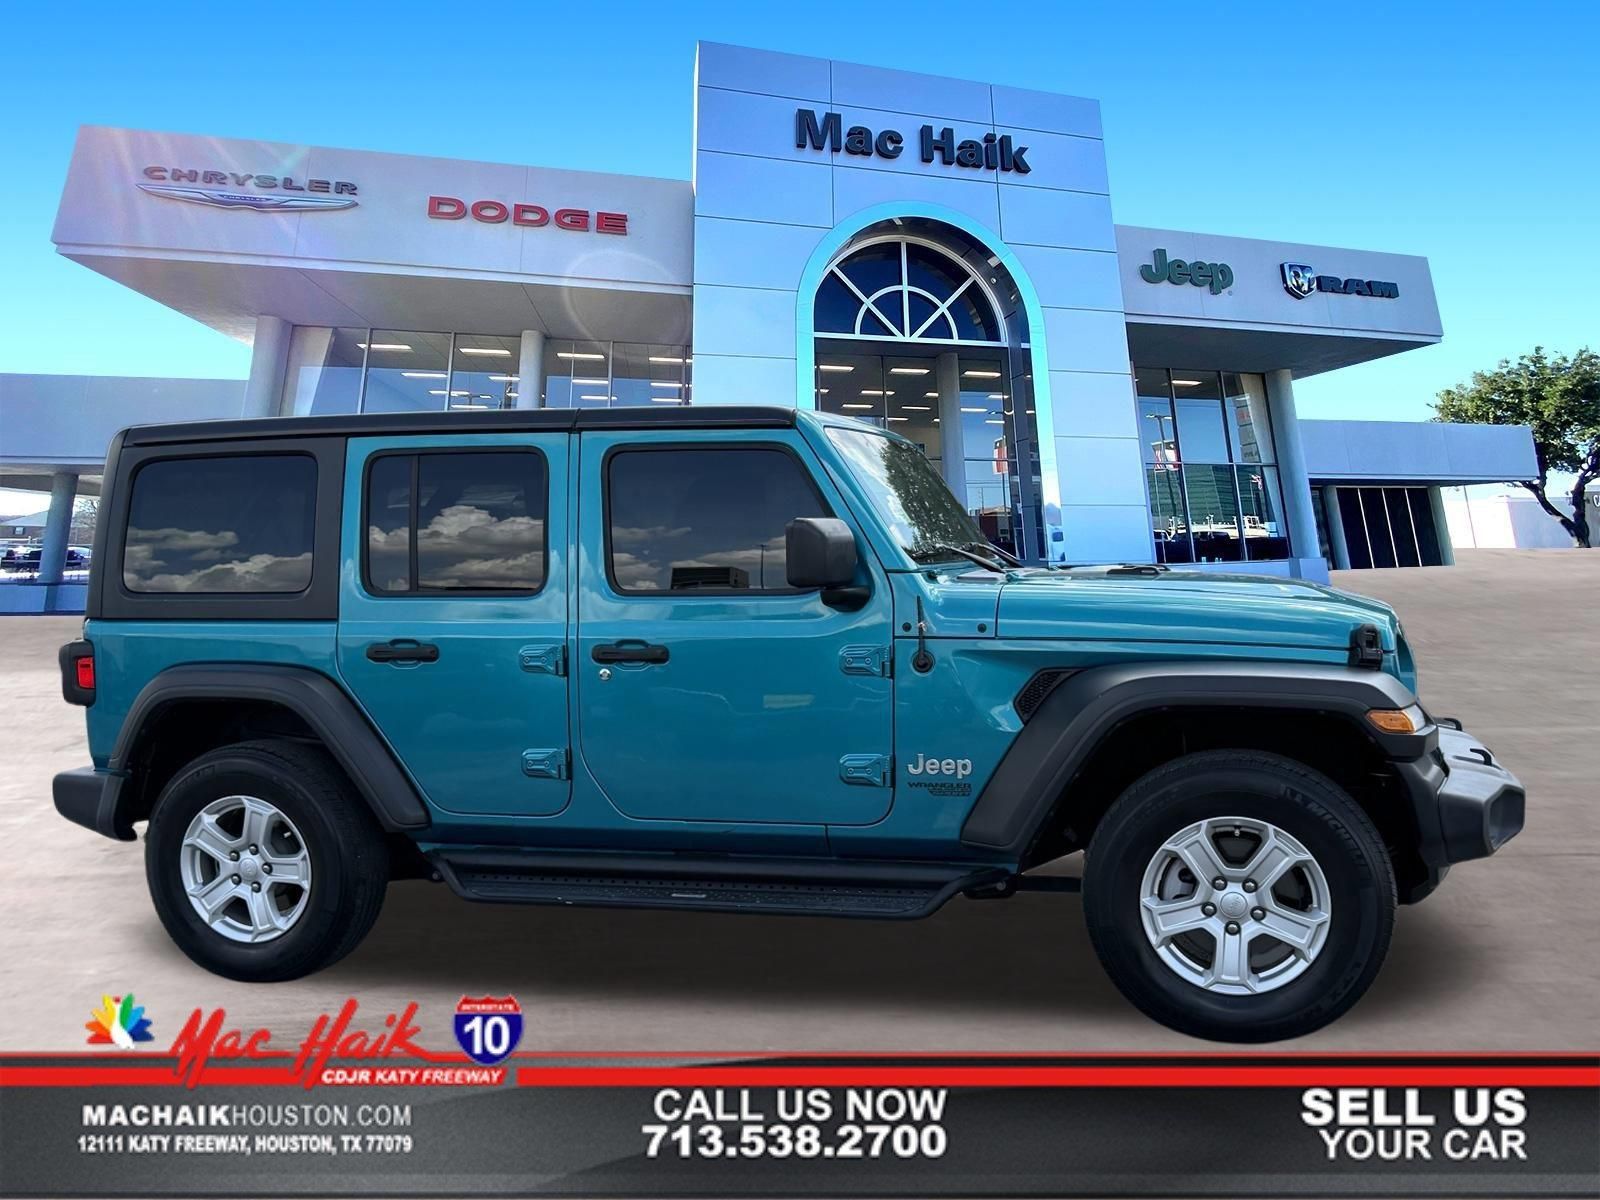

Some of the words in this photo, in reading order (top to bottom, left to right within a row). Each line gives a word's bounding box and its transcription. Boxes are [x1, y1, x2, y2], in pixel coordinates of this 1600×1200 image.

[795, 108, 904, 160] Mac
[919, 124, 1032, 174] Haik
[143, 165, 359, 196] CHRYSLER
[428, 195, 629, 236] DODGE
[1140, 248, 1234, 296] Jeep
[1316, 275, 1399, 299] RAM
[907, 753, 973, 779] Jeep
